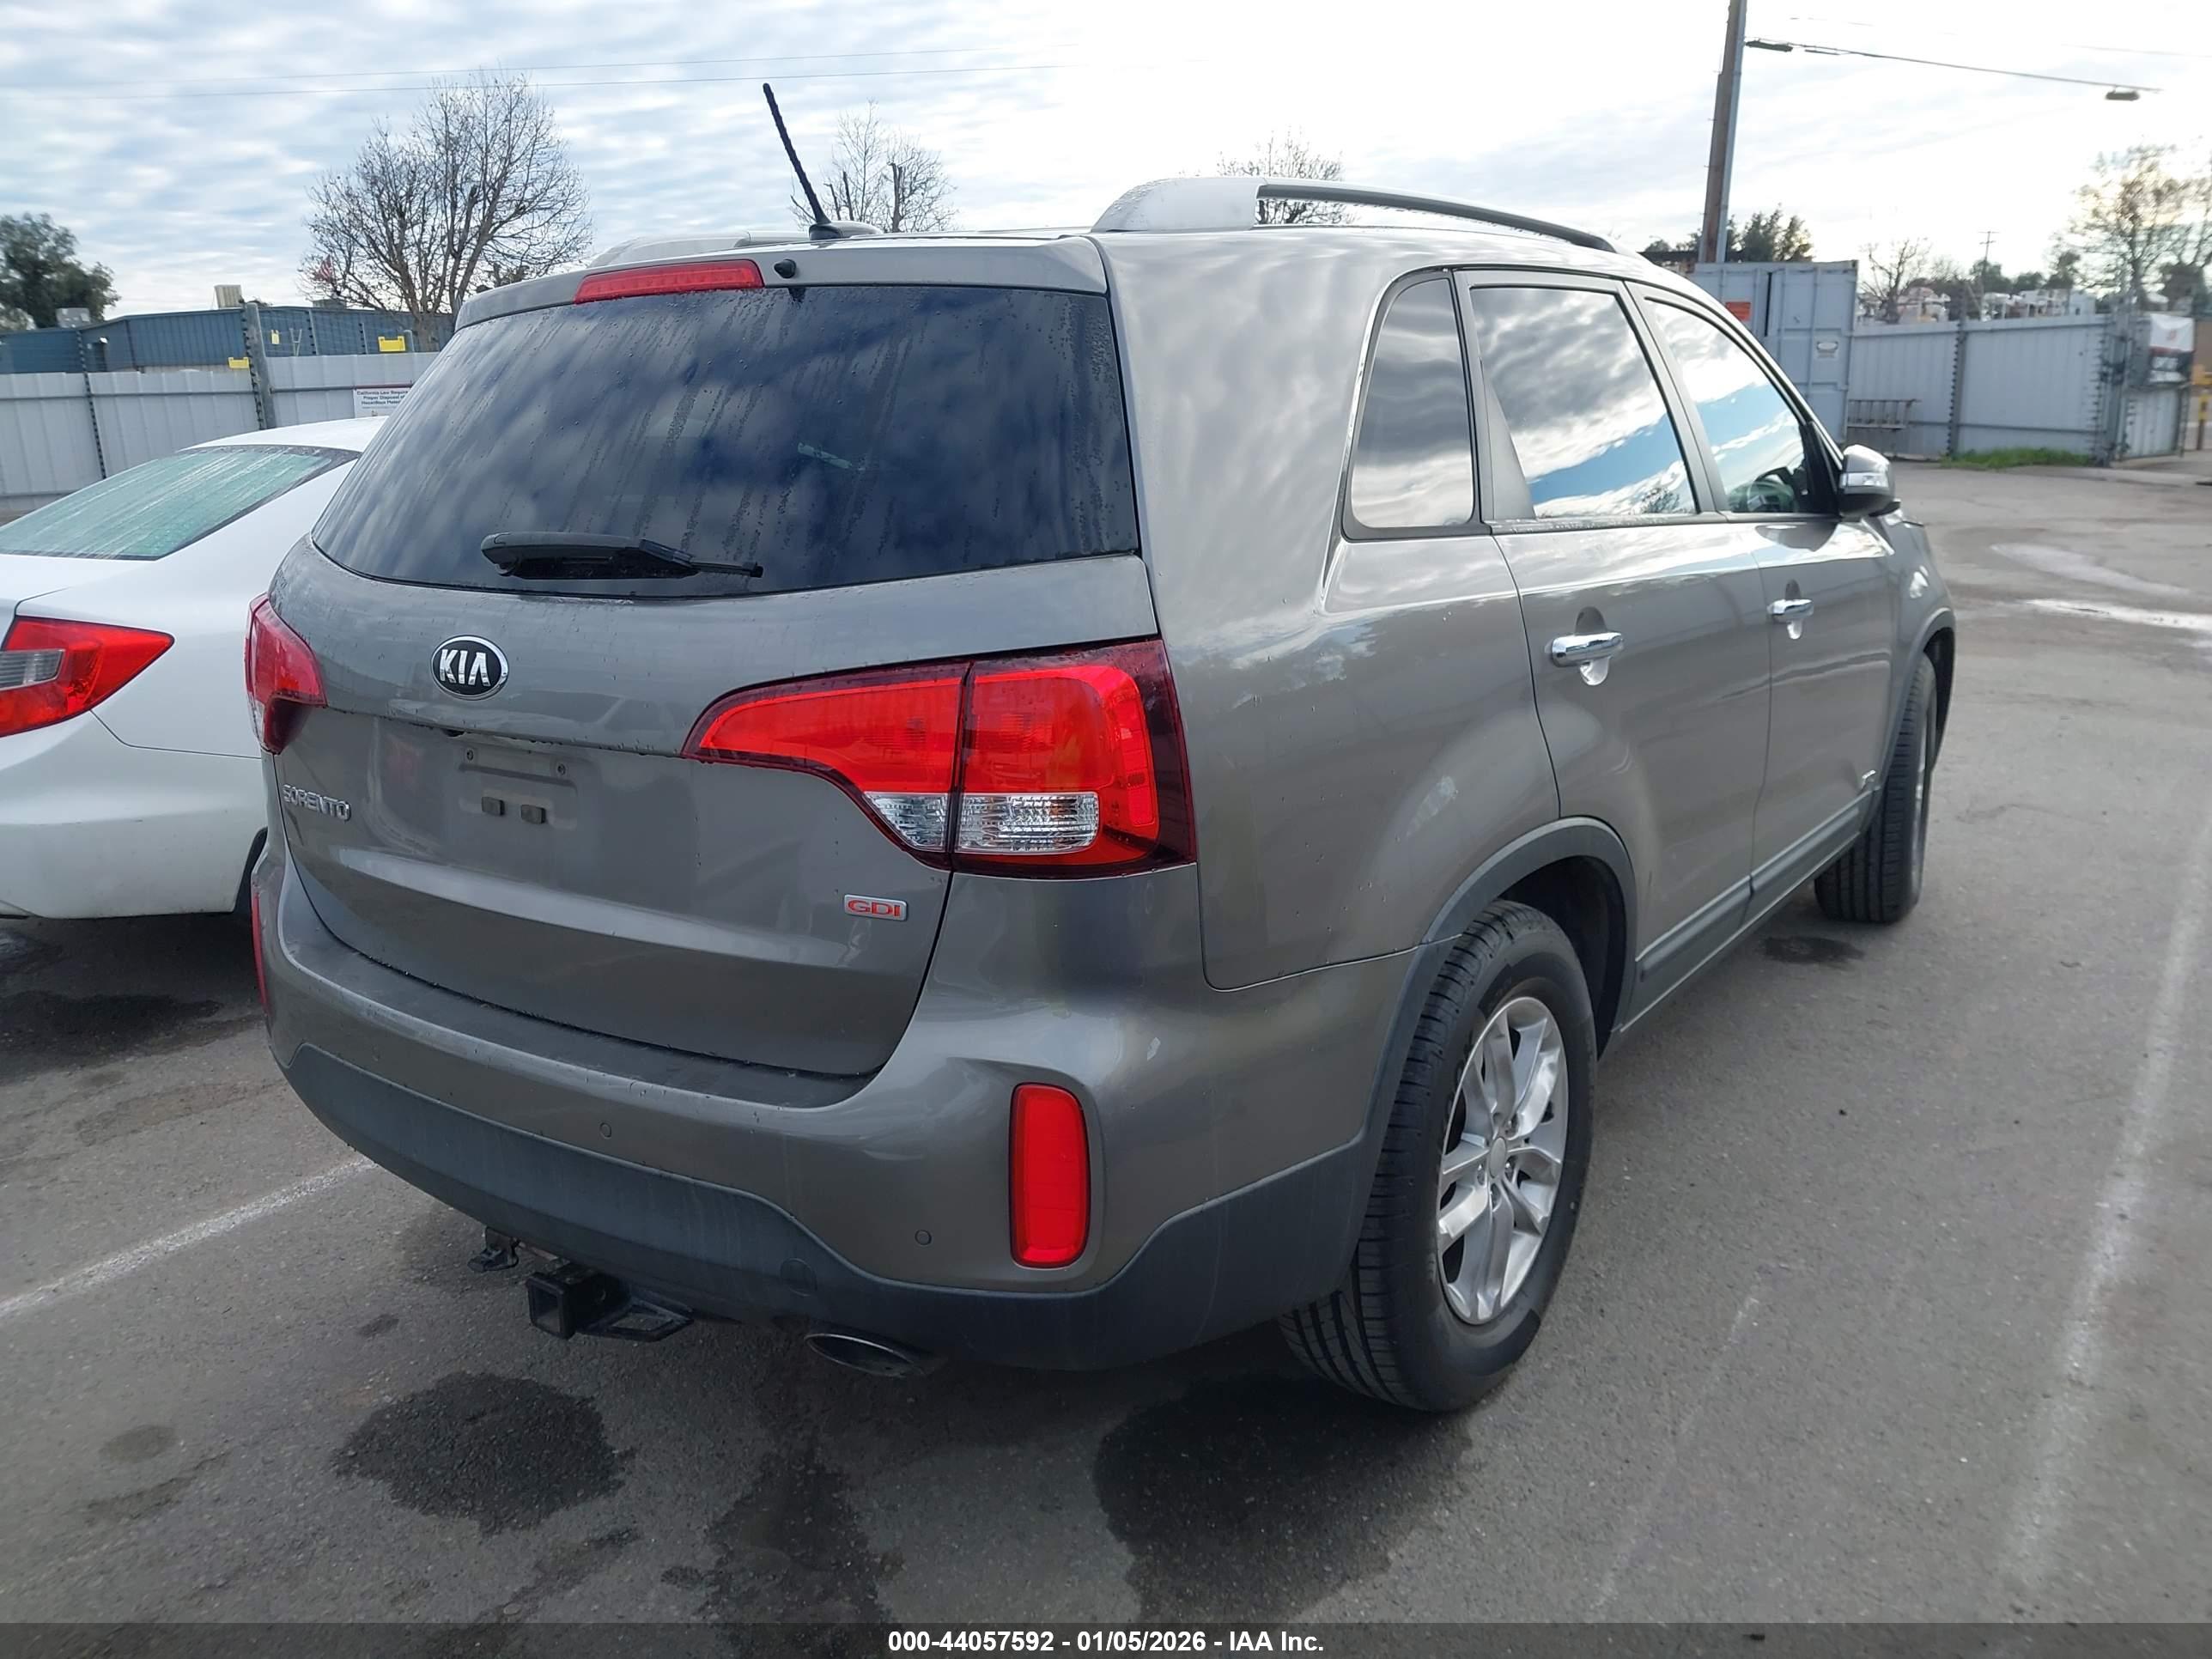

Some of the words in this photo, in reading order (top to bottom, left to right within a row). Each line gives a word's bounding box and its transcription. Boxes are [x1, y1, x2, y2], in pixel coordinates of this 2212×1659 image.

[439, 648, 491, 687] KIA
[283, 784, 350, 821] SORENTO
[848, 899, 901, 916] GDI
